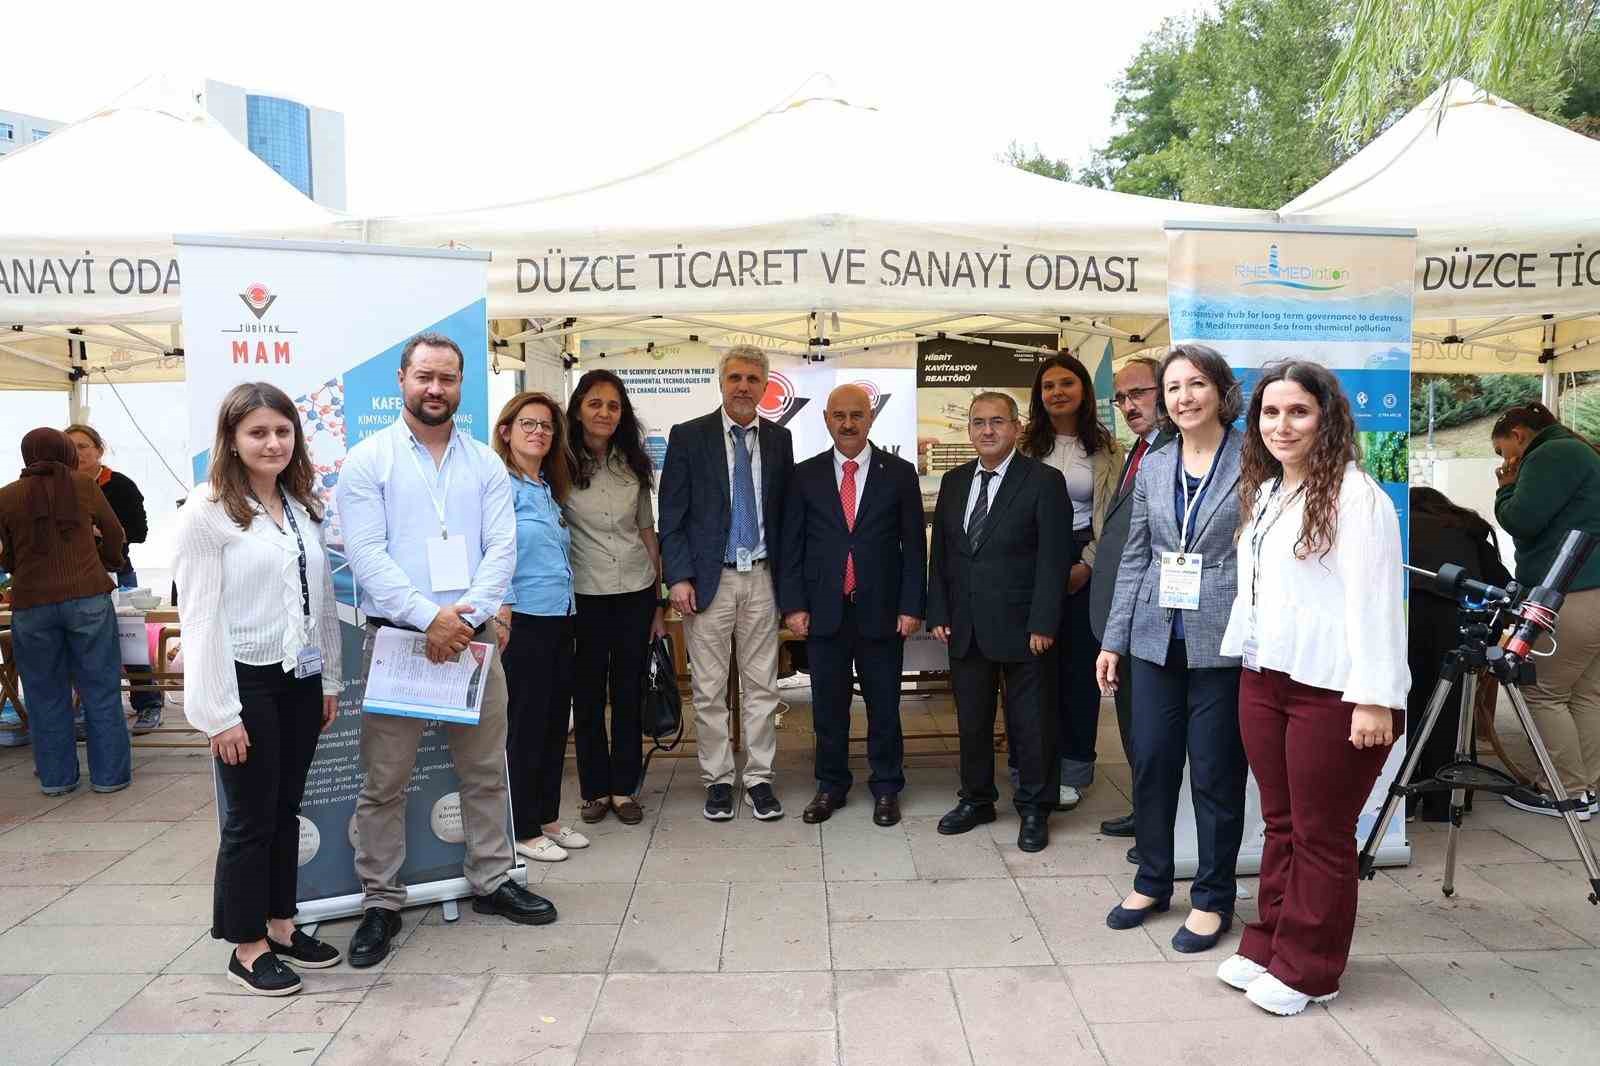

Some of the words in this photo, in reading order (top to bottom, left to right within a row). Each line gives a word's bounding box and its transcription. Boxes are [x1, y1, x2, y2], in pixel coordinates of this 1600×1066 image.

[516, 248, 636, 293] DÜZCE
[649, 243, 808, 289] TİCARET
[820, 248, 866, 285] VE
[880, 244, 1012, 289] SANAYİ
[1025, 254, 1139, 293] ODASI
[1423, 246, 1538, 291] DÜZCE
[1550, 243, 1600, 287] TİC
[1227, 310, 1246, 319] hub
[1247, 311, 1259, 319] for
[1261, 311, 1281, 320] long
[1283, 312, 1304, 320] term
[1306, 313, 1357, 321] governance
[1368, 313, 1403, 322] destress
[240, 322, 280, 334] TÜBİTAK
[1205, 321, 1270, 330] Mediterranean
[1272, 322, 1290, 330] Sea
[1291, 323, 1313, 331] from
[1354, 324, 1392, 333] pollution
[231, 340, 291, 364] MAM
[924, 353, 953, 362] HİBRİT
[628, 368, 657, 376] SCIENTIFIC
[657, 368, 684, 376] CAPACITY
[924, 364, 978, 372] KAVİTASYON
[623, 377, 661, 385] NVIRONMENTAL
[924, 374, 971, 382] REAKTÖRÜ
[372, 396, 405, 410] KAFE
